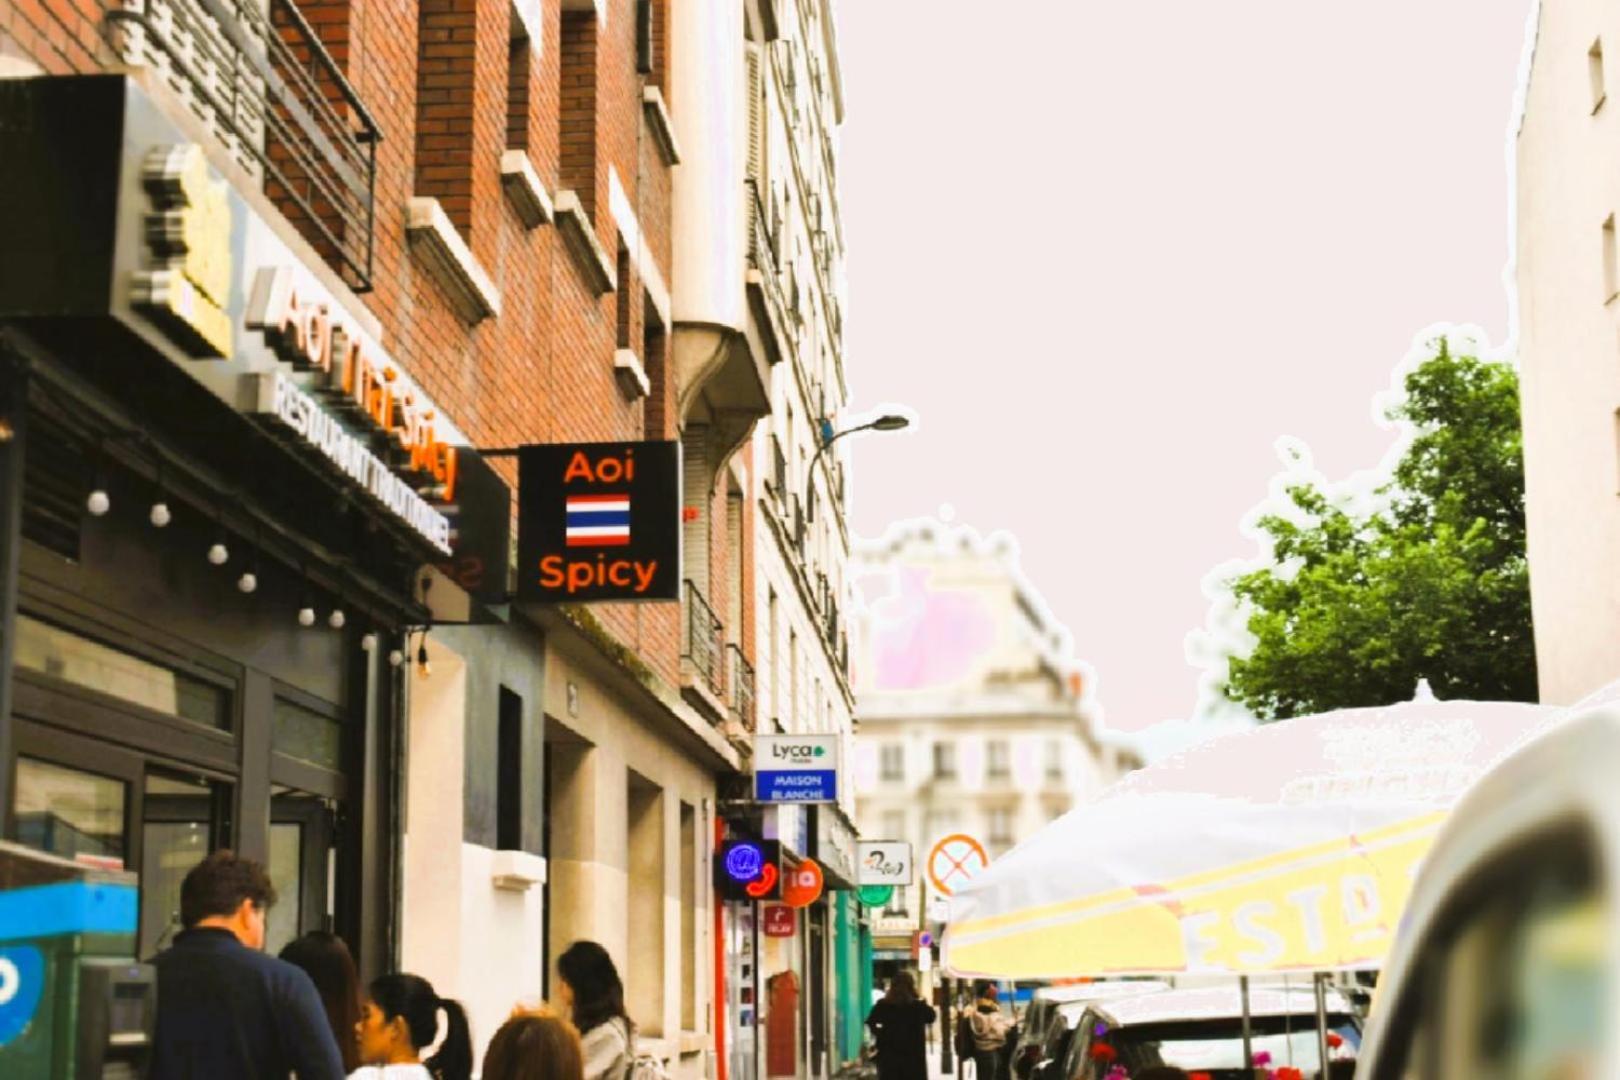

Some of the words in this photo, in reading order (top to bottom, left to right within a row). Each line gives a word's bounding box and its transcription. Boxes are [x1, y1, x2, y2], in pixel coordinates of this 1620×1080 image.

[564, 449, 635, 483] Aoi
[539, 553, 657, 593] Spicy
[772, 743, 812, 759] Lyca
[774, 775, 822, 786] MAISON
